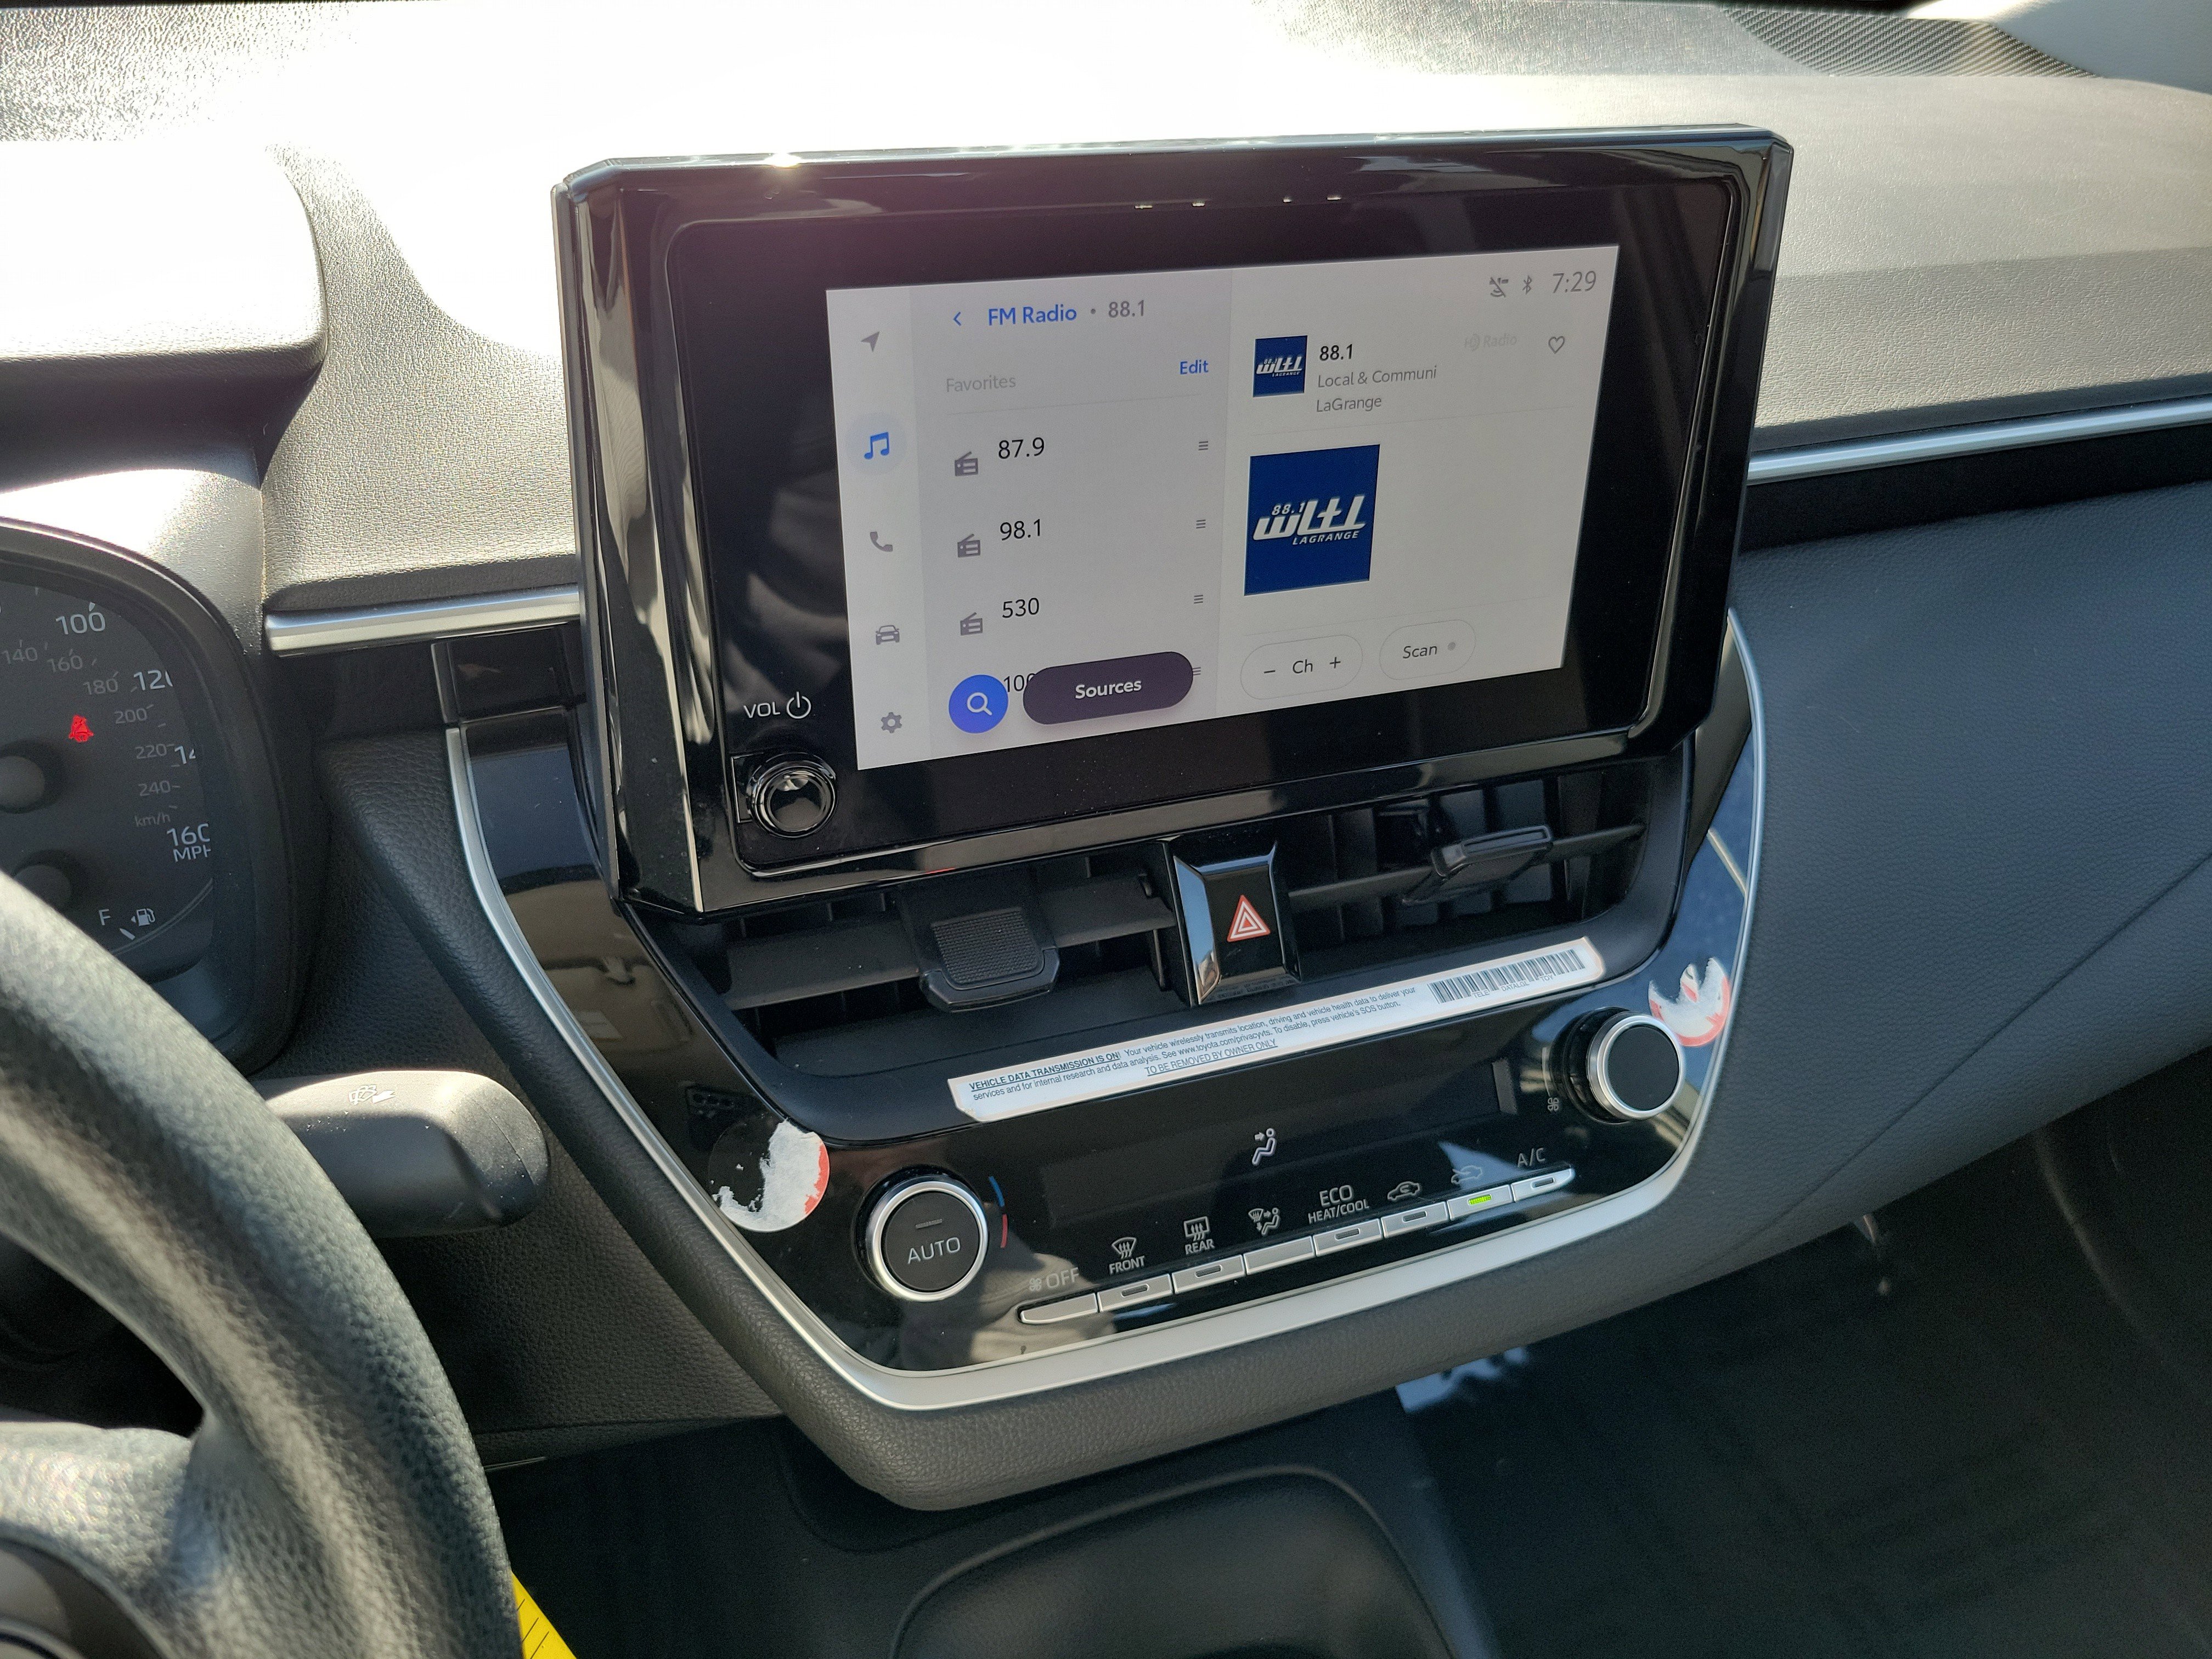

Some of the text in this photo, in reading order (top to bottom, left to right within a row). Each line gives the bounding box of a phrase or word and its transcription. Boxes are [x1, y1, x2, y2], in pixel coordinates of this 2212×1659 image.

[1553, 270, 1596, 294] 7:29
[988, 300, 1146, 326] FM Radio 88.1
[1319, 344, 1353, 362] 88.1
[1180, 360, 1209, 375] Edit
[1318, 365, 1437, 388] Local & Communi
[946, 374, 1017, 393] Favorites
[1316, 397, 1382, 413] LaGrange
[998, 437, 1045, 459] 87.9
[1271, 502, 1306, 516] 88.1
[1000, 519, 1042, 540] 98.1
[1292, 531, 1360, 545] LAGRANGE
[1002, 597, 1040, 619] 530
[55, 612, 105, 635] 100
[2, 647, 38, 664] 140
[1403, 644, 1437, 659] Scan
[47, 655, 82, 673] 160
[1293, 659, 1313, 674] Ch
[83, 678, 118, 695] 180
[1075, 679, 1142, 699] Sources
[115, 708, 147, 724] 200
[743, 702, 781, 718] VOL
[136, 743, 167, 759] 220
[138, 780, 171, 796] 240
[134, 812, 171, 827] km/h
[99, 910, 111, 926] F
[1472, 989, 1490, 998] TELE
[1540, 974, 1554, 983] TOY
[969, 1076, 1007, 1090] VEHICLE
[1008, 1071, 1031, 1082] DATA
[1031, 1057, 1094, 1077] TRANSMISSION
[1107, 1051, 1121, 1060] ON!
[1124, 1047, 1141, 1057] Your
[1143, 1042, 1168, 1053] vehicle
[1169, 1032, 1204, 1047] wirelessly
[1204, 1027, 1237, 1039] transmits
[1237, 1020, 1268, 1032] location,
[1268, 1014, 1292, 1025] driving
[1293, 1011, 1306, 1019] and
[1307, 1005, 1331, 1017] vehicle
[1331, 1000, 1353, 1012] health
[1354, 997, 1369, 1006] data
[1378, 990, 1400, 1001] deliver
[1400, 987, 1416, 997] your
[973, 1087, 1005, 1101] services
[1007, 1083, 1021, 1093] and
[1022, 1081, 1032, 1090] for
[1034, 1075, 1062, 1088] internal
[1063, 1065, 1096, 1081] research
[1097, 1062, 1111, 1073] and
[1111, 1060, 1128, 1070] data
[1130, 1054, 1161, 1066] analysis.
[1161, 1049, 1177, 1059] See
[1283, 1020, 1311, 1032] disable,
[1311, 1017, 1330, 1027] press
[1330, 1009, 1359, 1021] vehicle's
[1360, 1006, 1376, 1014] SOS
[1378, 1000, 1401, 1011] button.
[1144, 1039, 1277, 1075] TO BE REMOVED BY OWNER ONLY
[1517, 1148, 1546, 1168] A/C
[1319, 1185, 1353, 1206] ECO
[1308, 1198, 1369, 1224] HEAT/COOL
[907, 1237, 961, 1265] AUTO
[1185, 1239, 1215, 1255] REAR
[1109, 1256, 1145, 1276] FRONT
[1046, 1267, 1080, 1289] OFF
